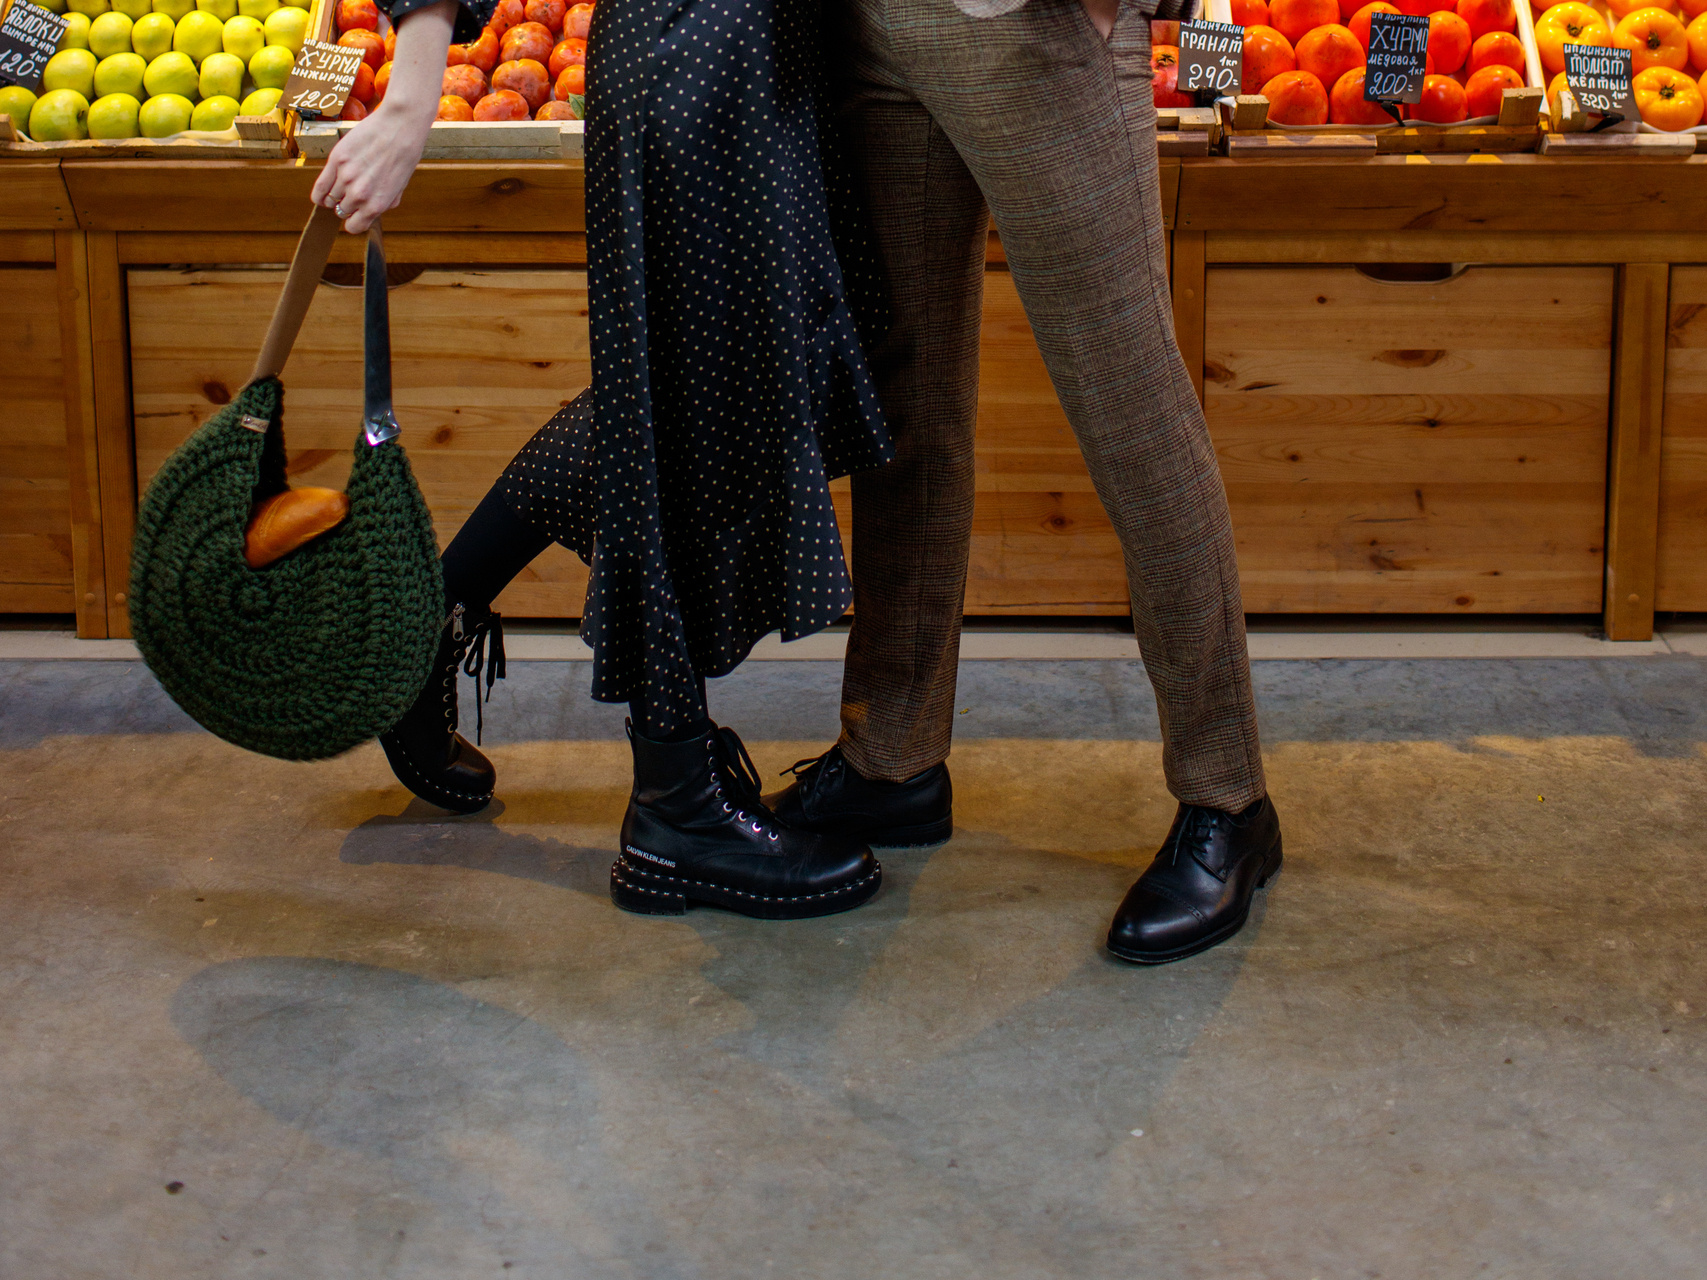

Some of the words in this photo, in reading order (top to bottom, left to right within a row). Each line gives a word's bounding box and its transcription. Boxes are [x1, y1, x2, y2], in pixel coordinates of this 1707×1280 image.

[4, 6, 65, 43] ЯБЛОКИ
[1181, 31, 1242, 53] ГРАНАТ
[298, 46, 361, 74] ХУРМА
[1219, 55, 1238, 66] 1кг
[1570, 54, 1624, 75] ТОМАТ
[291, 66, 356, 86] ИНЖИРНАЯ
[1408, 66, 1425, 76] 1кг
[332, 84, 349, 92] 1кг
[1611, 91, 1628, 100] 1кг
[626, 845, 643, 857] CALVIN
[643, 851, 658, 862] KLEIN
[657, 858, 676, 868] JEANS
